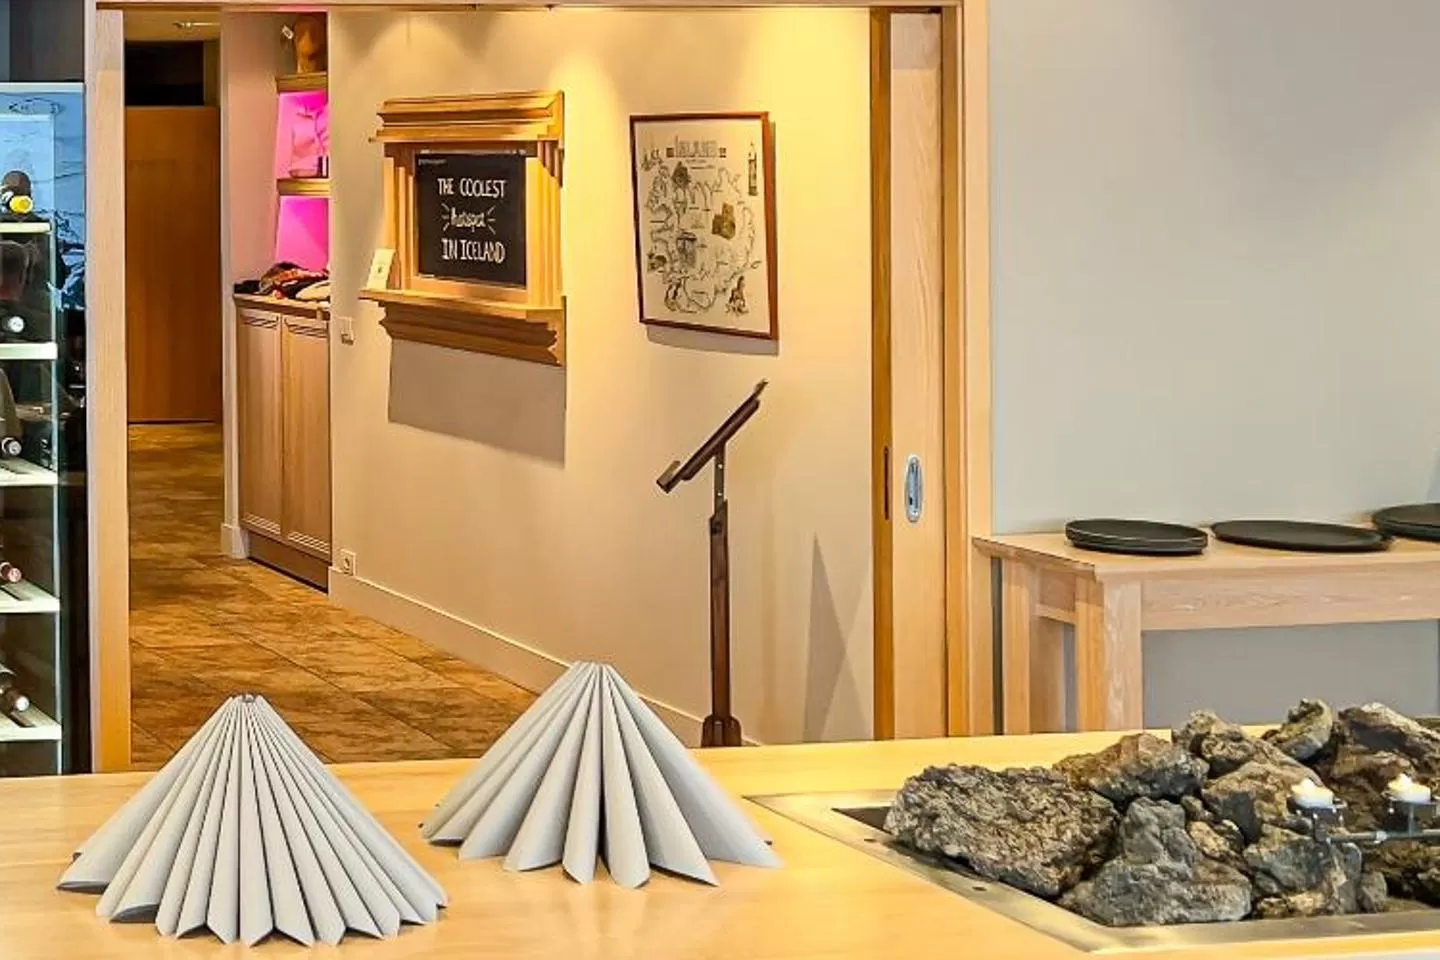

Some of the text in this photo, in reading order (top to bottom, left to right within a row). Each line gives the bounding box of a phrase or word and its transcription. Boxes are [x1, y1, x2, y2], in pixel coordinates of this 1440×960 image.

[437, 178, 507, 198] THE COOLEST
[441, 238, 506, 264] IN ICELAND
